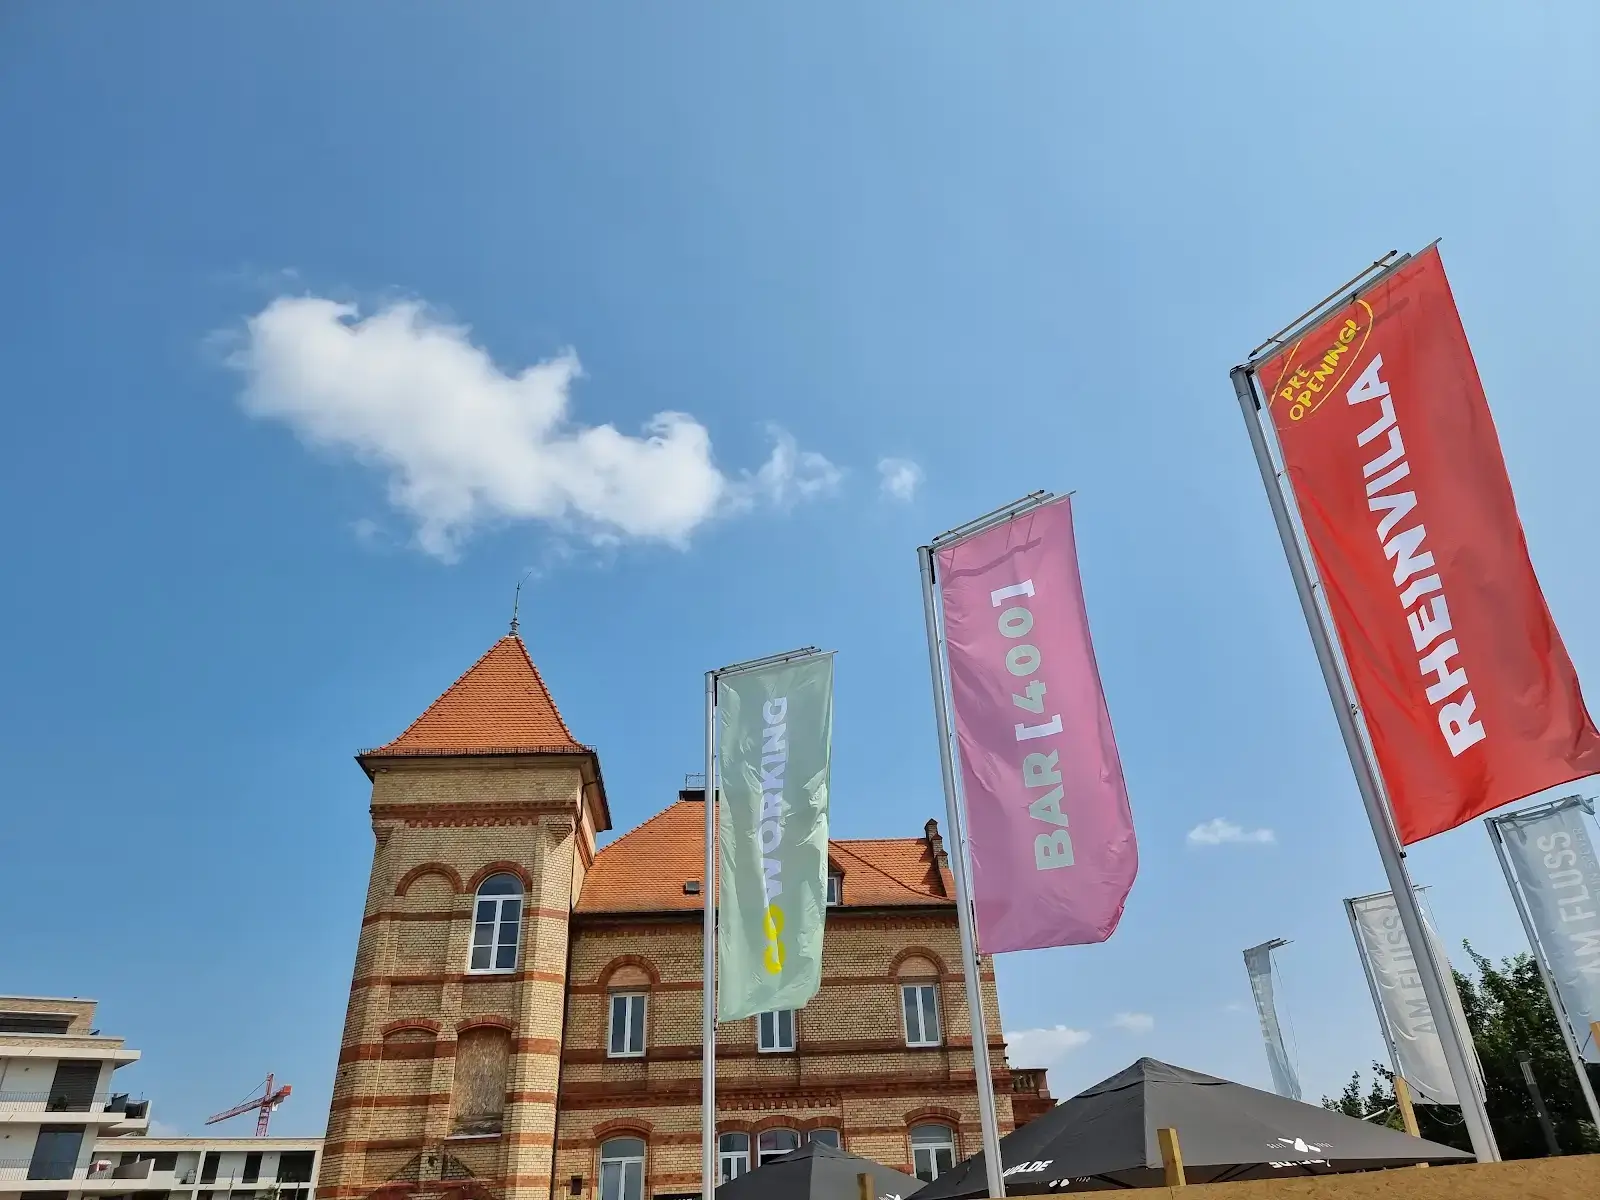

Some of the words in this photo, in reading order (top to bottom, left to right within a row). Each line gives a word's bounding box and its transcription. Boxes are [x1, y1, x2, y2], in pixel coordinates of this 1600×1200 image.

[1280, 363, 1311, 401] PRE
[1289, 319, 1361, 421] OPENING!
[1346, 352, 1487, 758] RHEINVILLA
[991, 578, 1063, 741] [400]
[1023, 749, 1075, 870] BAR
[1537, 831, 1597, 923] FLUSS
